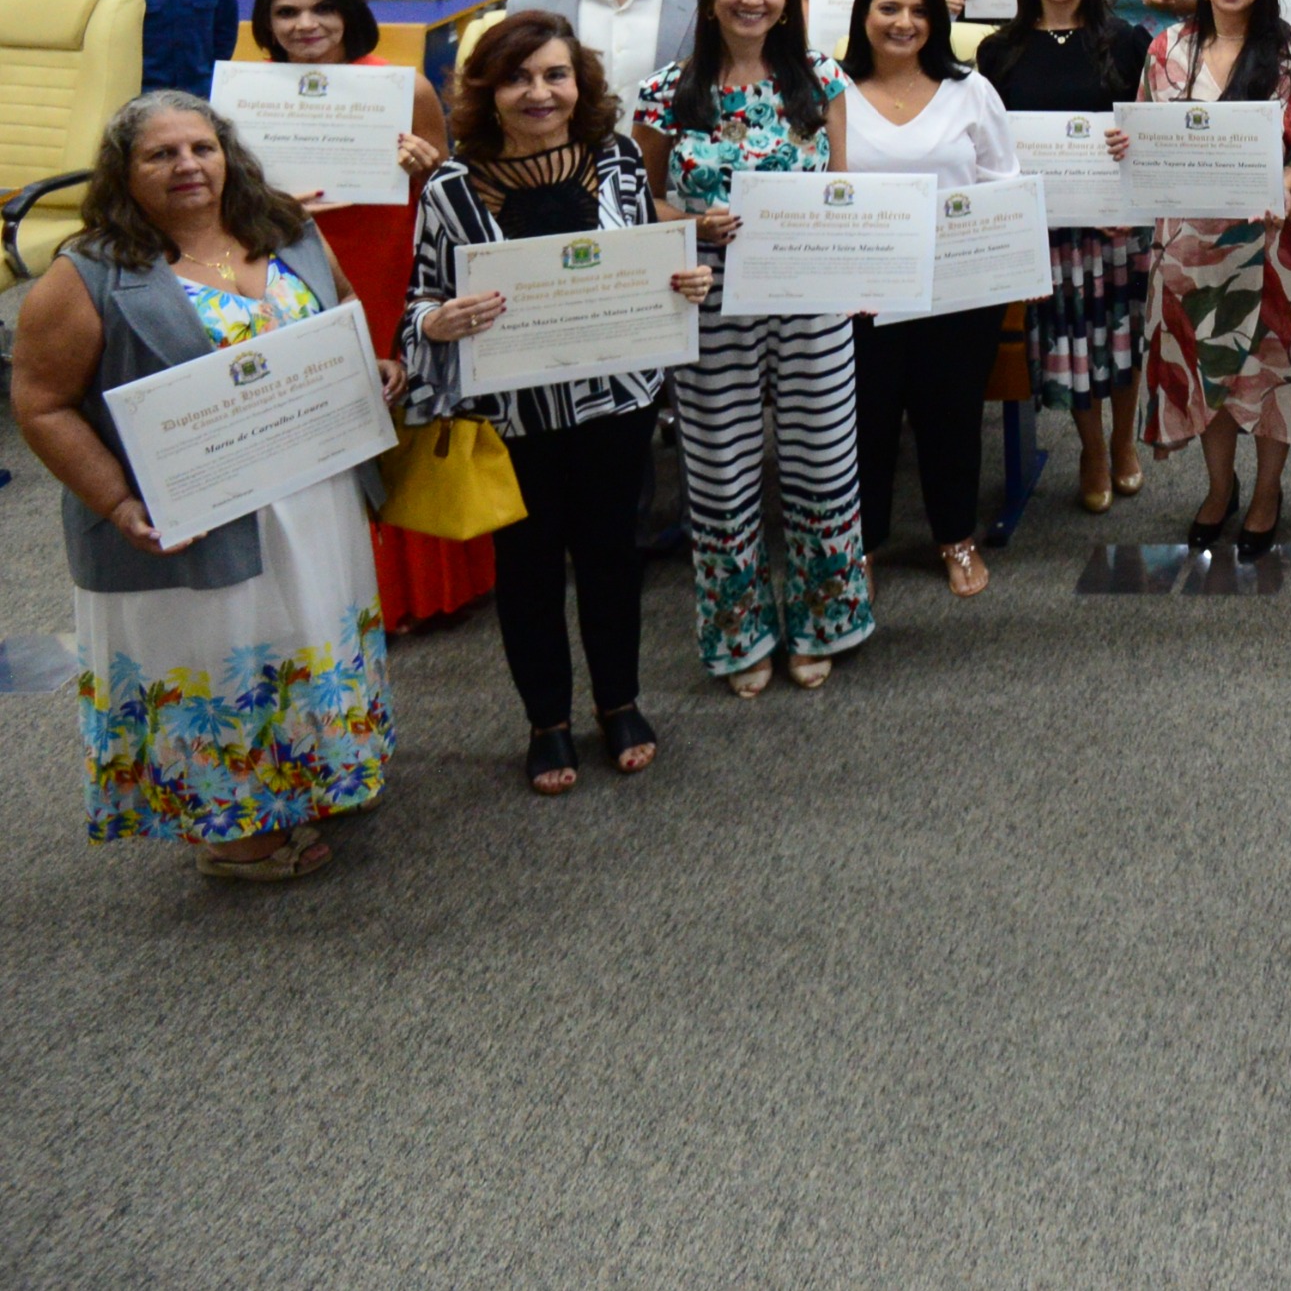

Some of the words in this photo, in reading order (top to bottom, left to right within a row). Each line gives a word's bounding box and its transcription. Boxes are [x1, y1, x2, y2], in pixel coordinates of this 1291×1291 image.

[237, 100, 281, 109] Diploma
[284, 100, 294, 109] de
[299, 101, 332, 110] Honra
[350, 101, 385, 111] Mérito
[1138, 133, 1173, 142] Diploma
[1188, 133, 1214, 141] Honra
[1229, 132, 1258, 142] Mérito
[759, 210, 805, 219] Diploma
[809, 210, 819, 218] de
[825, 210, 858, 219] Honra
[877, 210, 910, 220] Mérito
[948, 218, 977, 230] Honra
[978, 217, 990, 225] ao
[992, 210, 1023, 223] Mérito
[943, 248, 972, 259] Moreira
[973, 246, 984, 254] dos
[986, 242, 1010, 251] Santos
[531, 317, 557, 326] Maria
[559, 313, 589, 322] Gomes
[160, 402, 220, 433] Diploma
[221, 394, 237, 408] de
[239, 377, 282, 402] Honra
[284, 372, 299, 384] ao
[301, 353, 344, 377] Mérito
[236, 432, 247, 441] de
[249, 412, 295, 436] Carvalho
